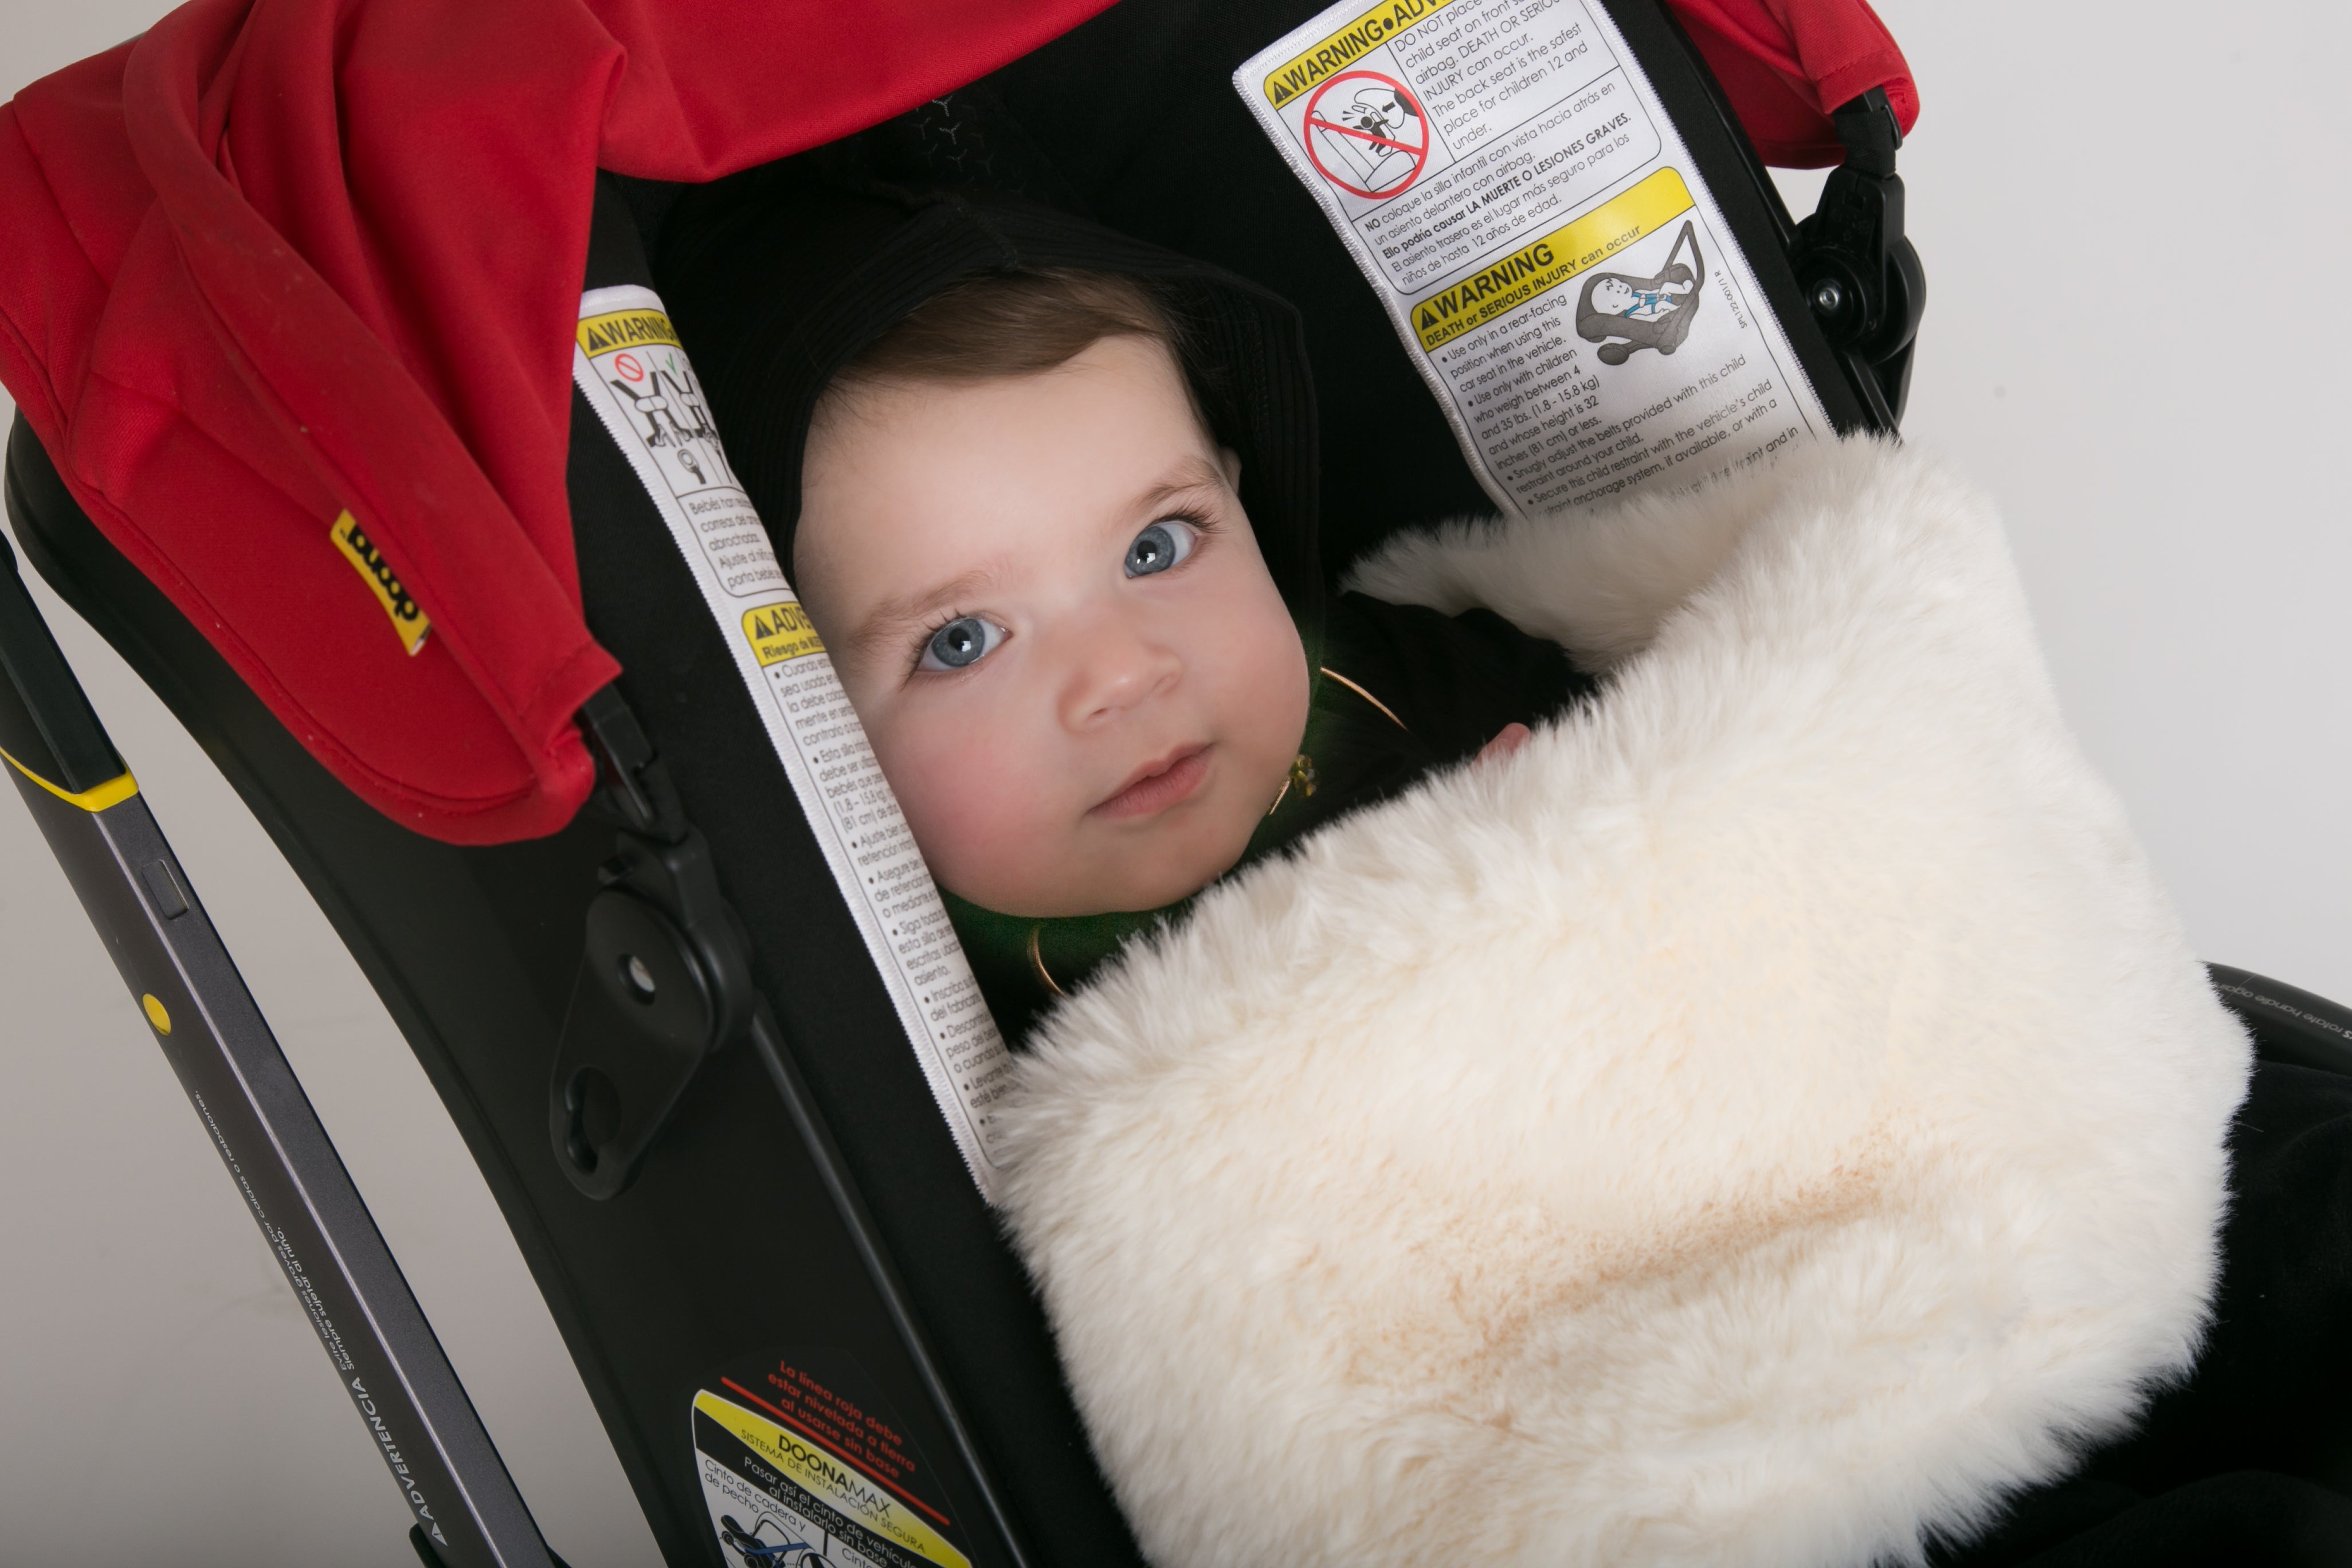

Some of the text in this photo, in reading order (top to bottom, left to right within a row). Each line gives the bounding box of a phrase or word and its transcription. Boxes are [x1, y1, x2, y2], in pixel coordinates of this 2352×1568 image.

[1393, 32, 1417, 53] DO
[1416, 13, 1445, 40] NOT
[1405, 0, 1511, 69] child seat on front
[1414, 0, 1559, 85] airbag. DEATH OR SERIO
[1422, 32, 1534, 103] INJURY can occur.
[1431, 21, 1582, 118] The back seat is the safest
[1442, 39, 1589, 138] place for children 12 and
[1363, 82, 1616, 233] NO coloque la silla infantil con vista hacia atrás en
[1452, 123, 1493, 151] under.
[1381, 112, 1632, 260] Ello podría causar LA MUERTE O LESIONES GRAVES.
[1425, 225, 1641, 347] DEATH or SERIOUS INJURY can occur
[1433, 243, 1555, 319] WARNING
[1447, 293, 1568, 360] Use only in a rear-facing
[1449, 316, 1562, 381] position when using this
[1459, 336, 1567, 393] car seat in the vehicle.
[1473, 348, 1578, 405] Use only with children
[1496, 416, 1602, 471] inches (81 cm) or less.
[726, 569, 756, 591] porta
[761, 641, 800, 660] Riesgo
[781, 659, 819, 679] Cuando
[786, 693, 826, 714] la debe
[818, 748, 842, 764] Esta
[818, 765, 848, 783] debe
[824, 778, 859, 799] bebés
[897, 938, 922, 955] esta
[898, 918, 923, 935] Siga
[913, 965, 952, 986] asiento.
[2255, 995, 2343, 1032] rotate handle
[945, 1040, 972, 1060] peso
[962, 1047, 996, 1071] cuando
[969, 1066, 1005, 1090] Levante
[194, 1089, 348, 1371] Evite lesiones graves por caídas o resbalones.
[276, 1226, 355, 1371] Siempre sujetar al niño.
[767, 1373, 916, 1473] estar nivelada a tierra
[779, 1359, 797, 1379] La
[834, 1397, 863, 1421] roja
[864, 1416, 903, 1447] debe
[351, 1376, 435, 1521] ADVERTENCIA
[780, 1398, 900, 1479] al usarse sin base
[704, 1472, 760, 1514] de pecho
[704, 1459, 806, 1533] Cinto de cadera y
[740, 1428, 926, 1554] SISTEMA DE INSTALACIÓN SEGURA
[744, 1455, 778, 1485] Pasar
[779, 1481, 798, 1498] así
[798, 1493, 811, 1507] el
[812, 1502, 844, 1527] cinto
[846, 1523, 864, 1540] de
[778, 1433, 891, 1519] DOONAMAX
[769, 1486, 781, 1500] al
[782, 1494, 837, 1535] instalarlo
[838, 1530, 854, 1547] sin
